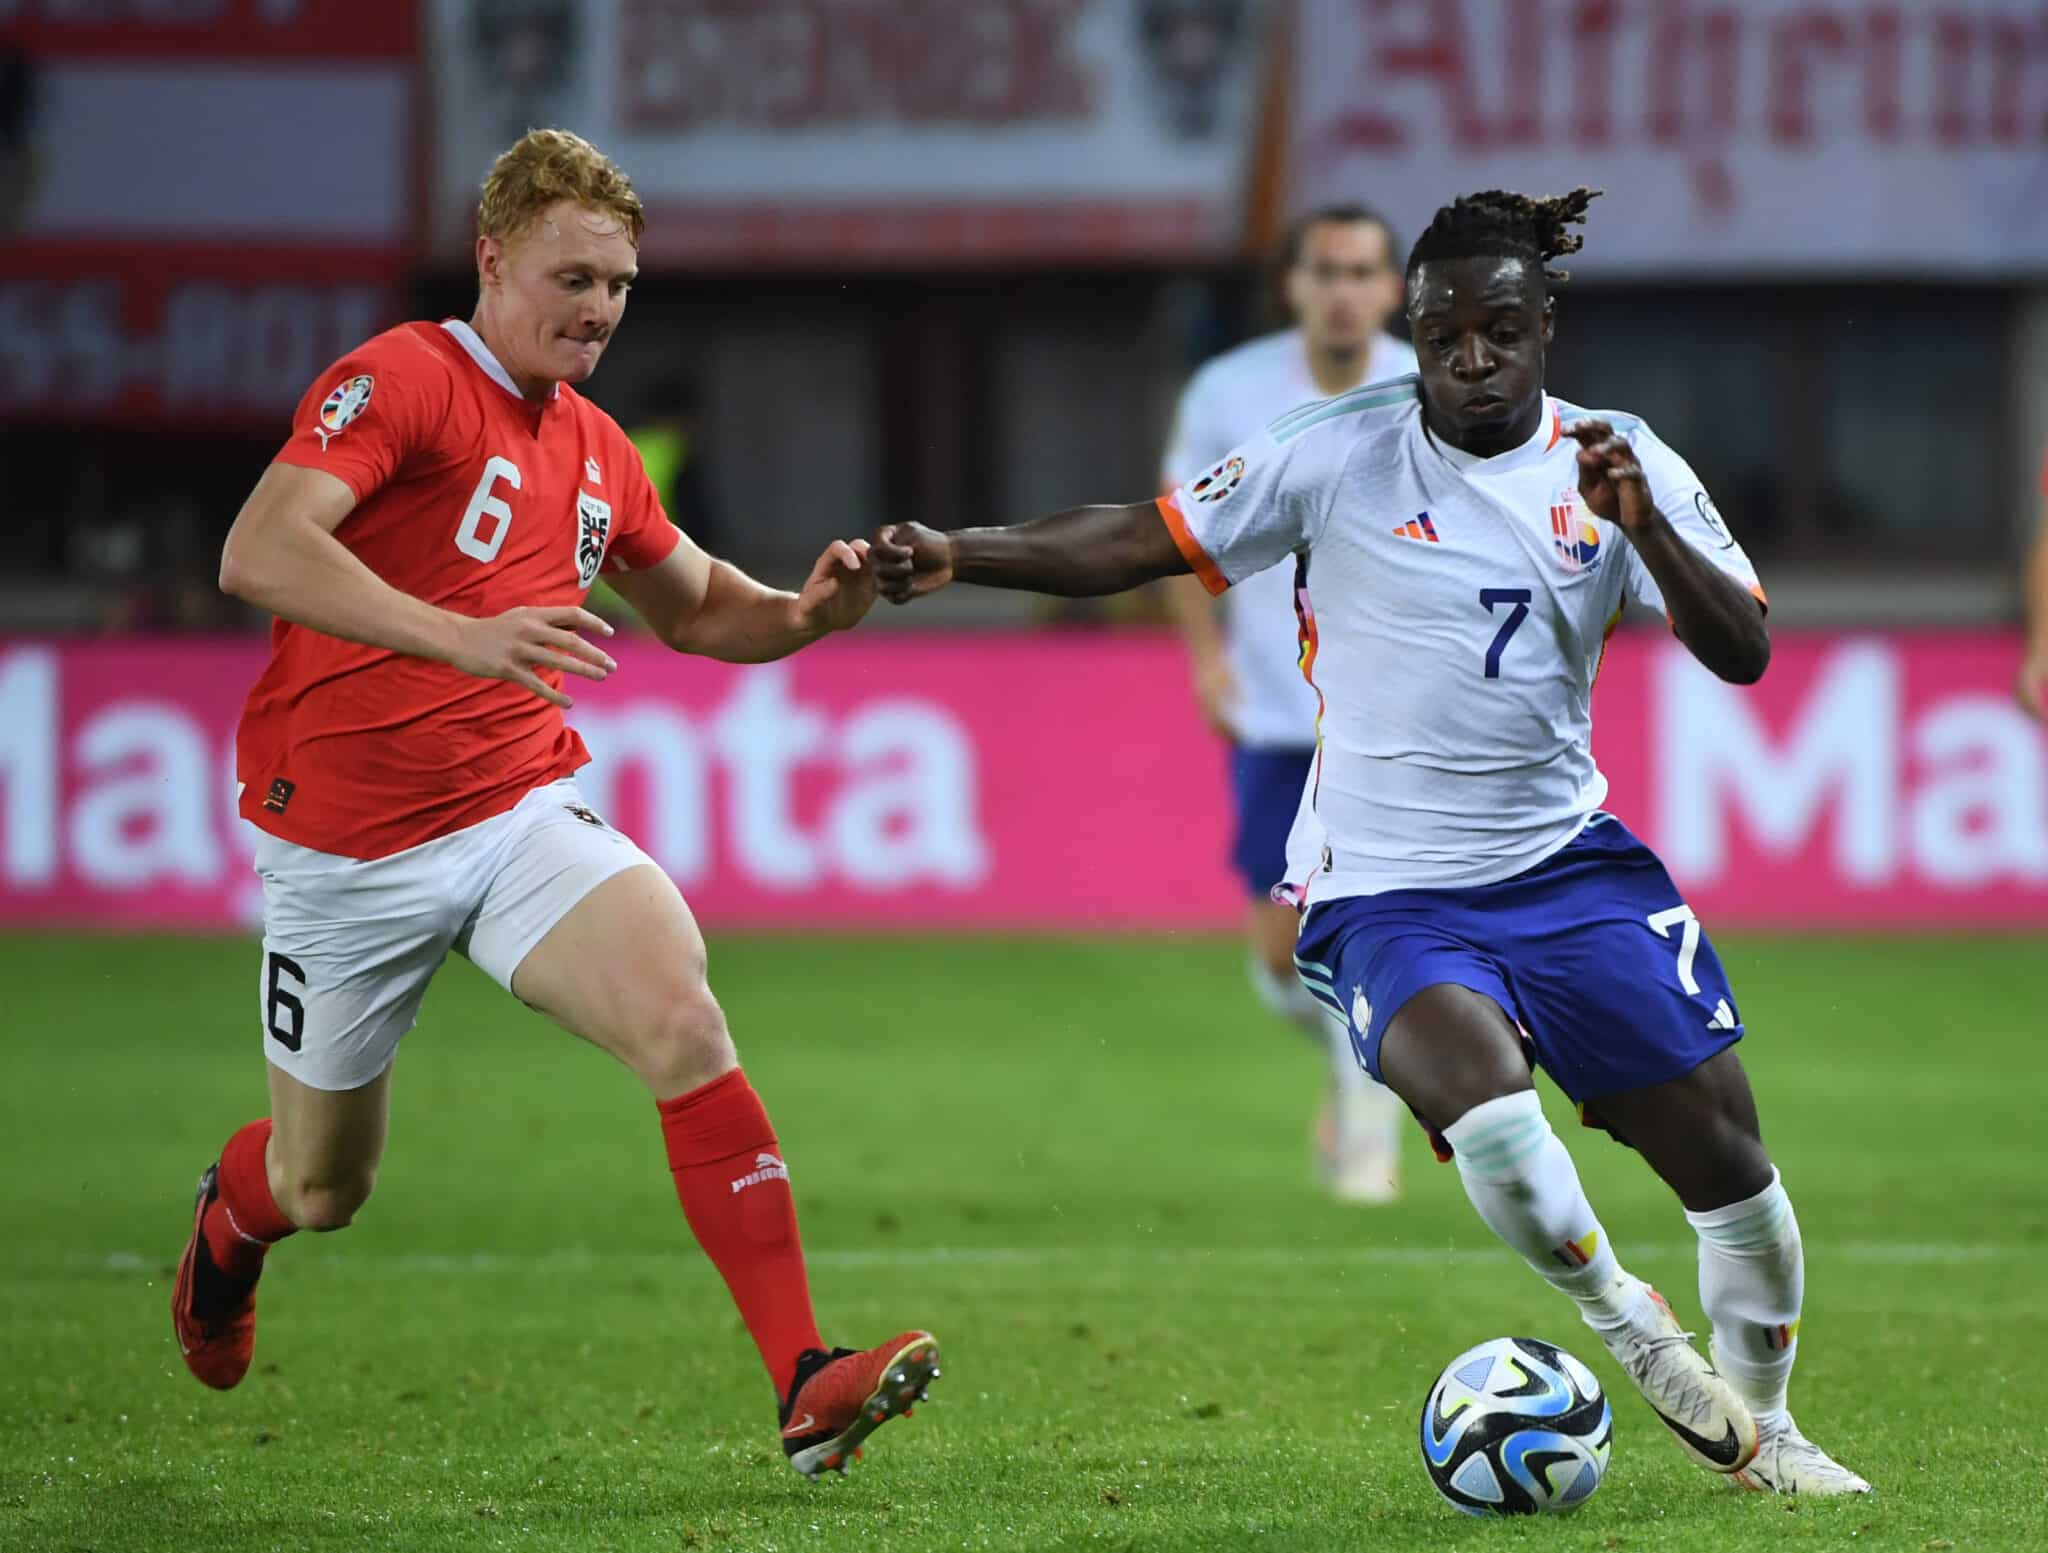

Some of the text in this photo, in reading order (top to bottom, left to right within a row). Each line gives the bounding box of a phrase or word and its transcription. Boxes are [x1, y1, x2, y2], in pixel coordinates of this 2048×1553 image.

[454, 456, 522, 564] 6
[1479, 588, 1531, 679] 7
[1647, 904, 1702, 996] 7
[266, 951, 306, 1052] 6
